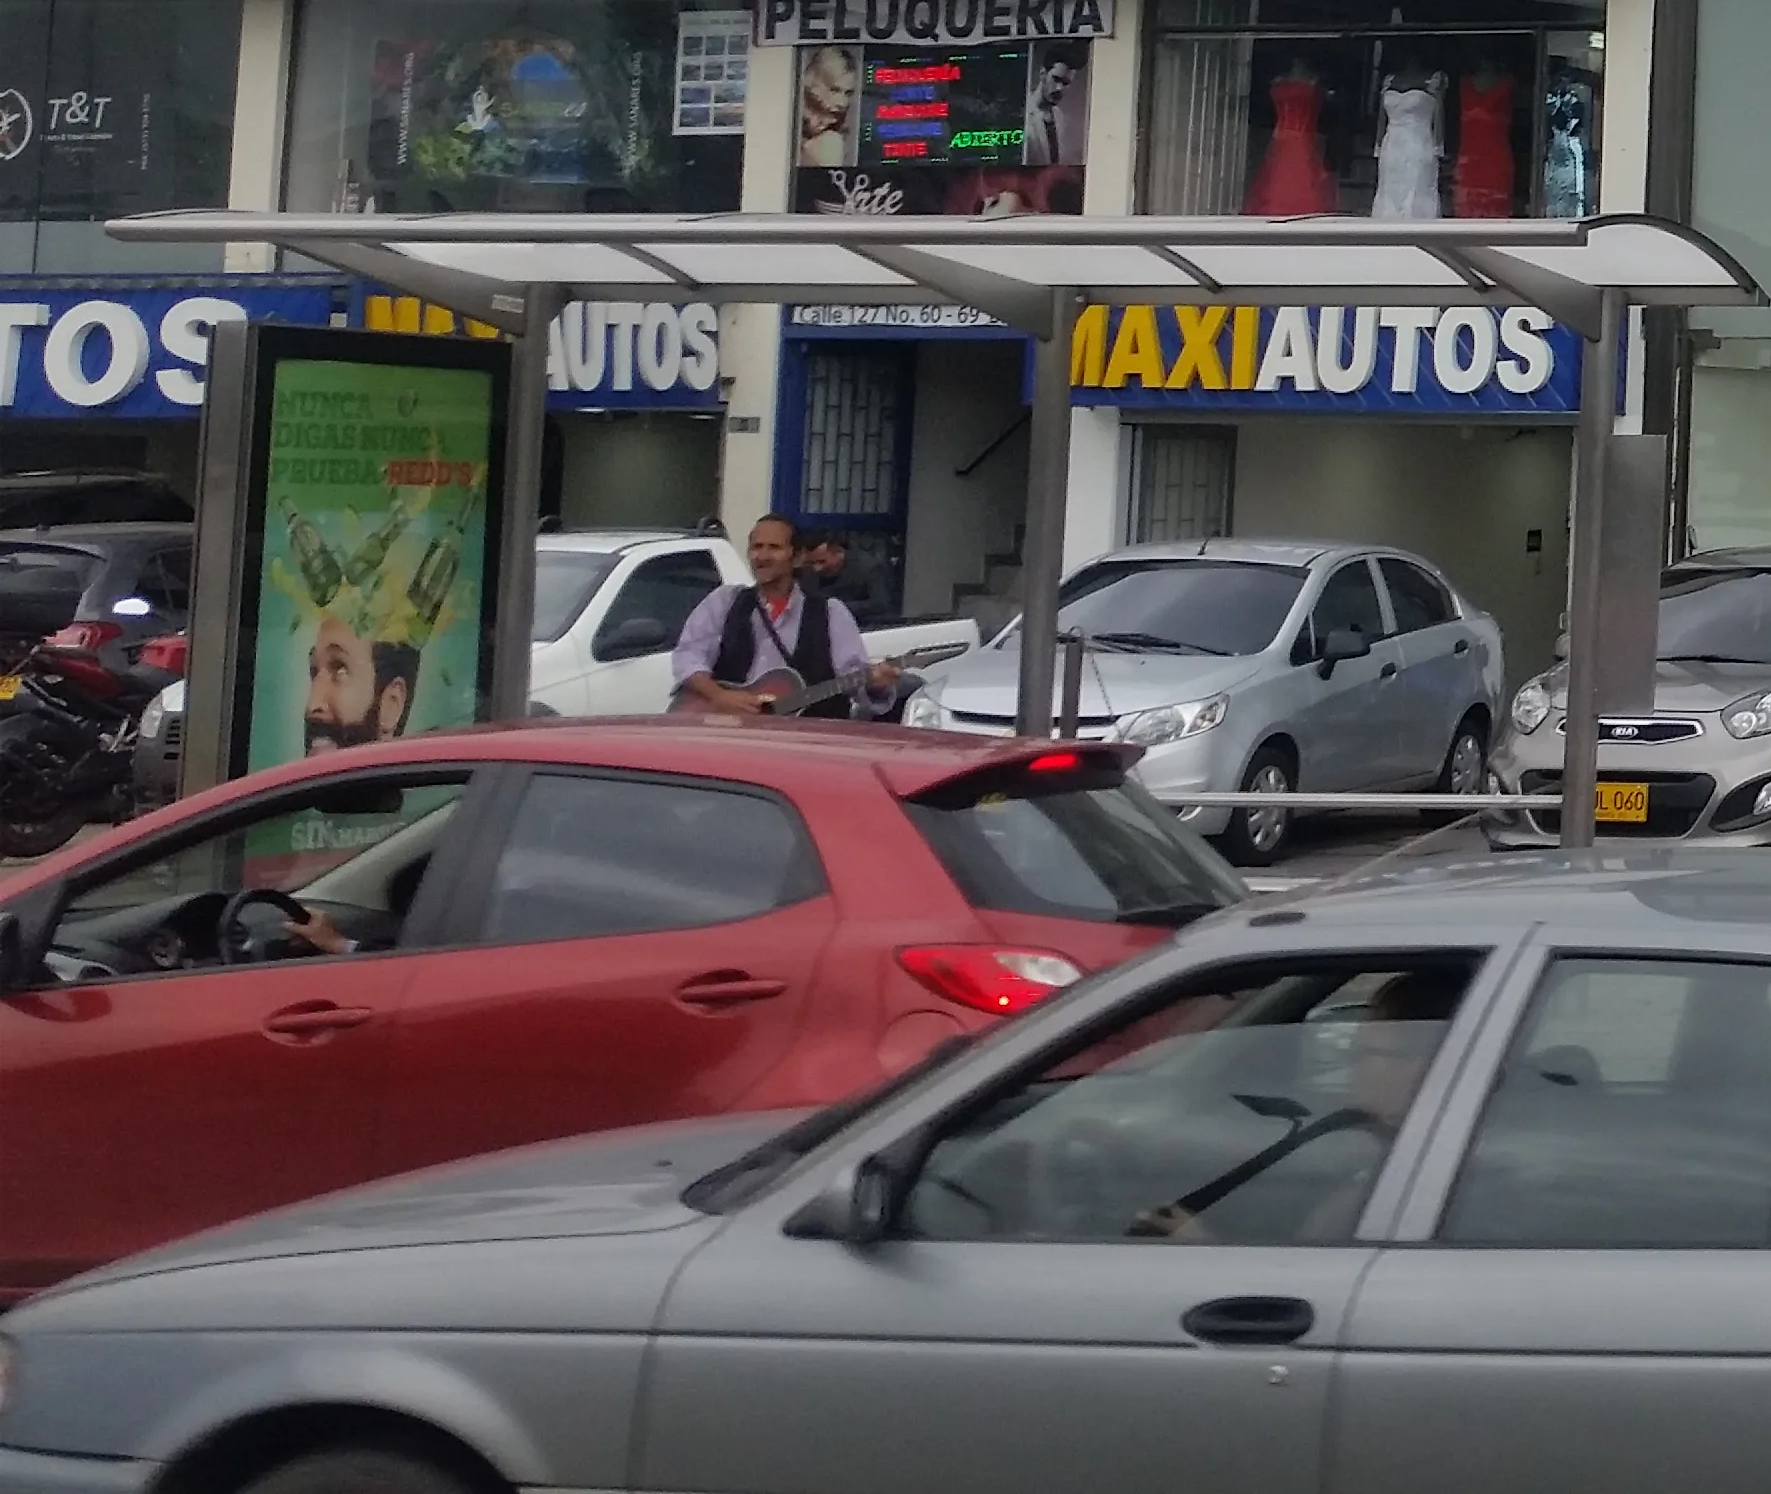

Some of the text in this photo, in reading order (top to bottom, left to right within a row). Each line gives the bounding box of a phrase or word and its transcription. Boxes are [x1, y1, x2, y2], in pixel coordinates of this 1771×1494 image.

[48, 91, 112, 130] T&T
[800, 306, 842, 323] Calle
[850, 306, 877, 323] 127
[886, 306, 916, 323] No.
[920, 306, 942, 323] 60
[957, 306, 979, 324] 69
[276, 391, 372, 419] NUNCA
[275, 421, 357, 449] DIGAS
[1615, 727, 1634, 736] KIA
[1614, 790, 1645, 811] 060
